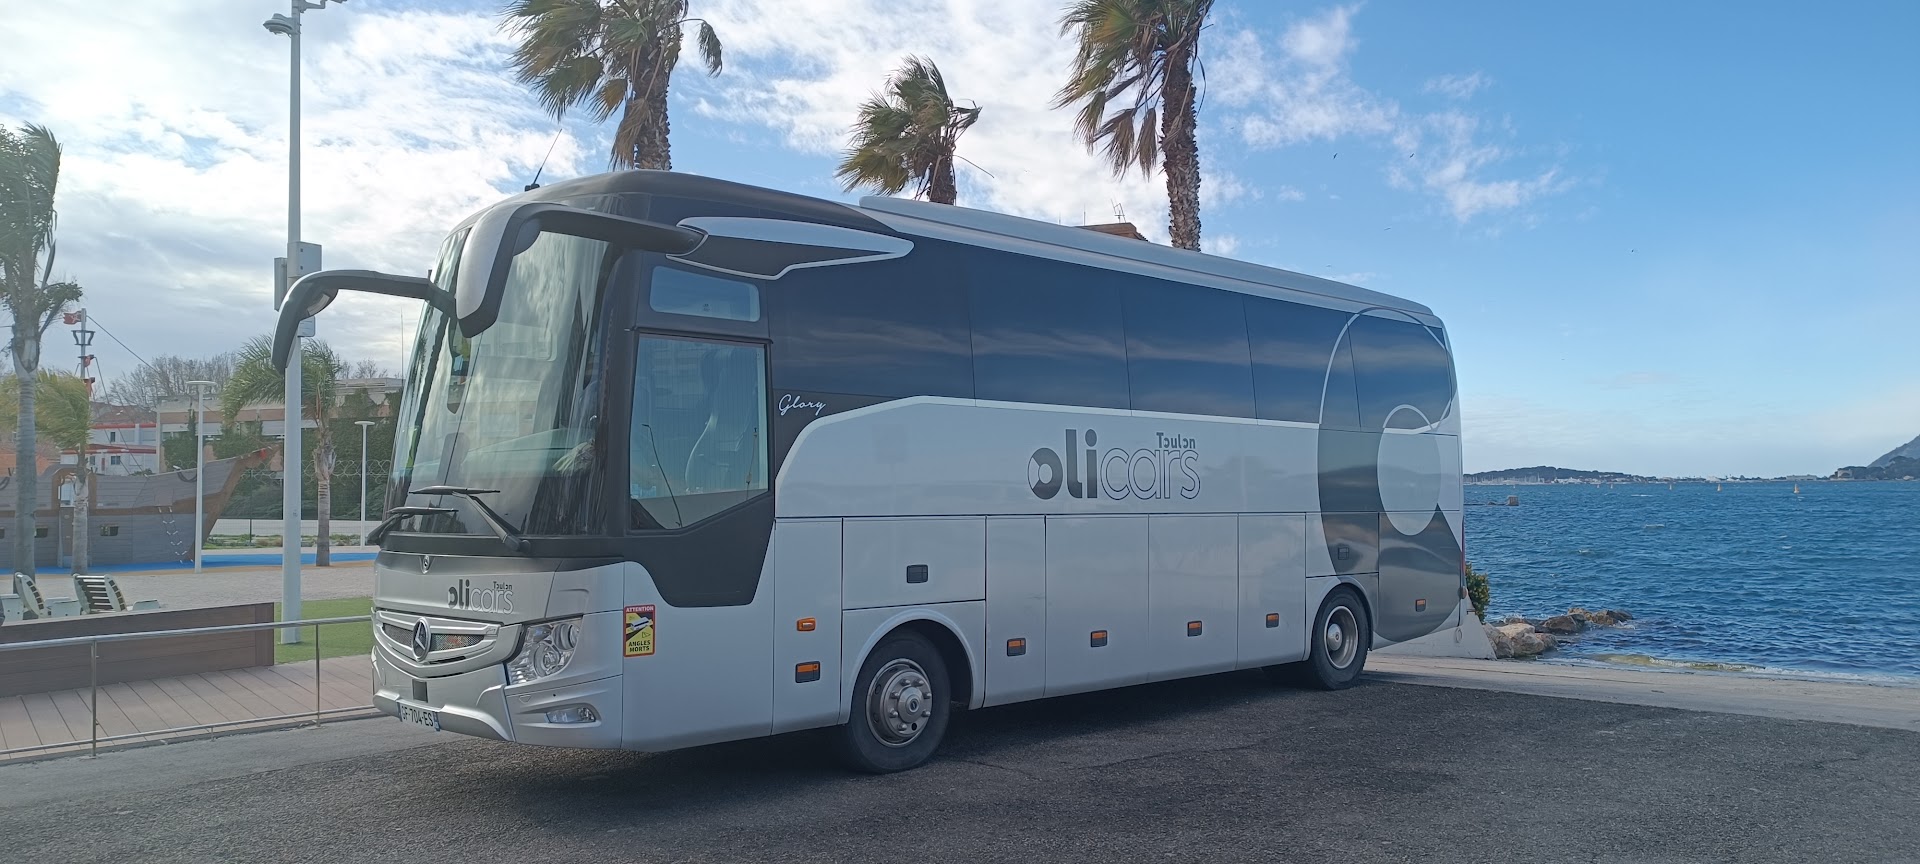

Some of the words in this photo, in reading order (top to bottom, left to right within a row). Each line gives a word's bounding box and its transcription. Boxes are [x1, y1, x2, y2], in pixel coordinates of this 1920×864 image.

[778, 394, 827, 416] Glory
[1156, 432, 1196, 449] Toulon
[1027, 429, 1200, 500] olicars
[447, 579, 514, 615] olicars
[626, 605, 654, 613] ATTENTION
